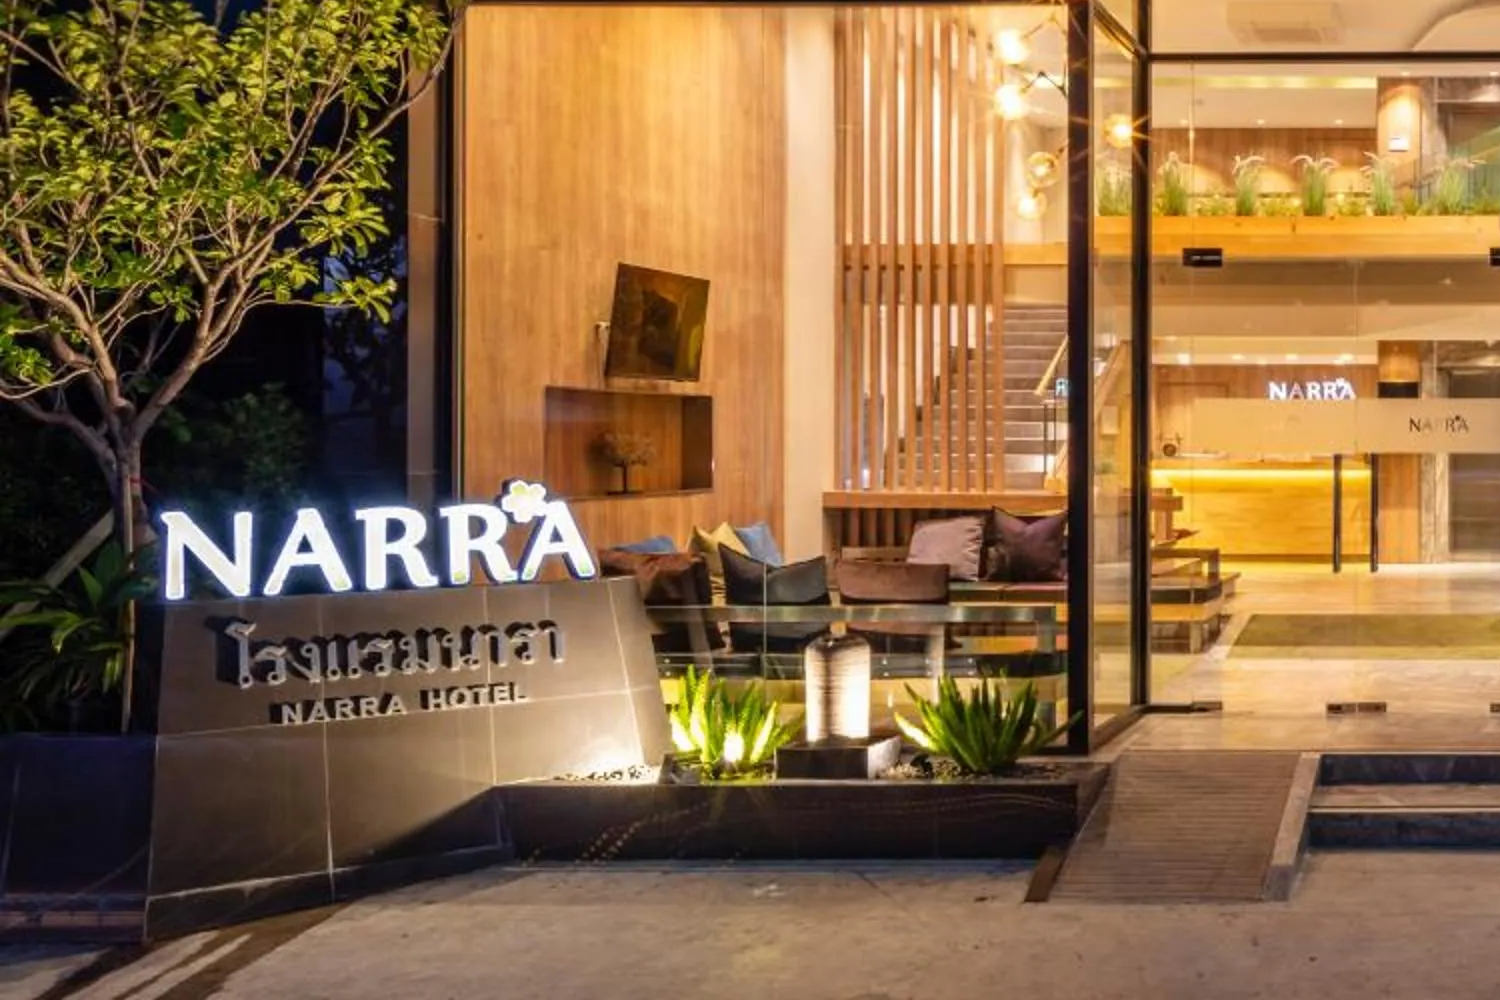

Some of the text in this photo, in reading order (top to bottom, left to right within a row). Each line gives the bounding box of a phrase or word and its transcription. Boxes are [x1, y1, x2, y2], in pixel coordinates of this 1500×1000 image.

[1268, 378, 1356, 400] NARRA
[1408, 415, 1469, 432] NARA
[161, 497, 596, 599] NARRA
[224, 621, 566, 688] โรงแรมนารา
[281, 682, 532, 726] NARRA HOTEL
